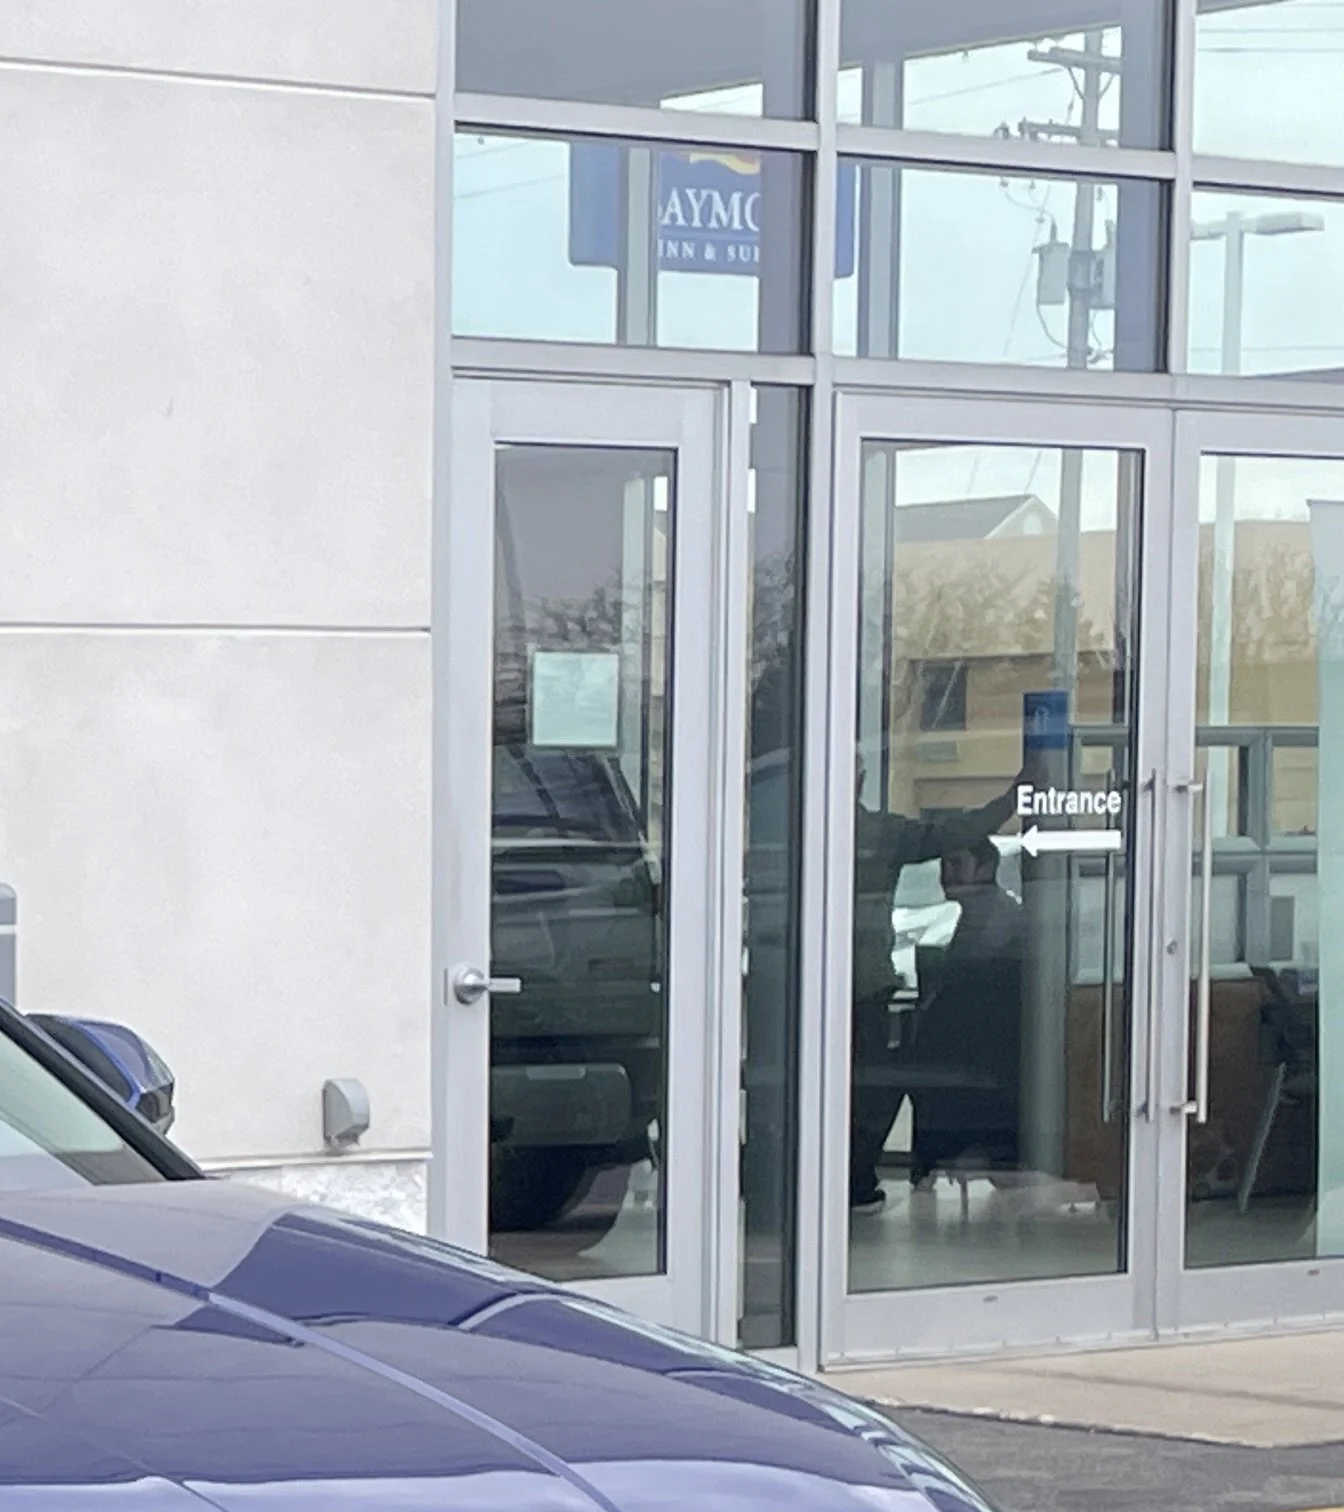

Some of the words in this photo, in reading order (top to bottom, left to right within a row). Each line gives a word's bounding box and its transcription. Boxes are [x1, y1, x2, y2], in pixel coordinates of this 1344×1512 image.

[657, 187, 762, 232] AYMO
[704, 242, 717, 261] &
[1016, 784, 1122, 816] Entrance
